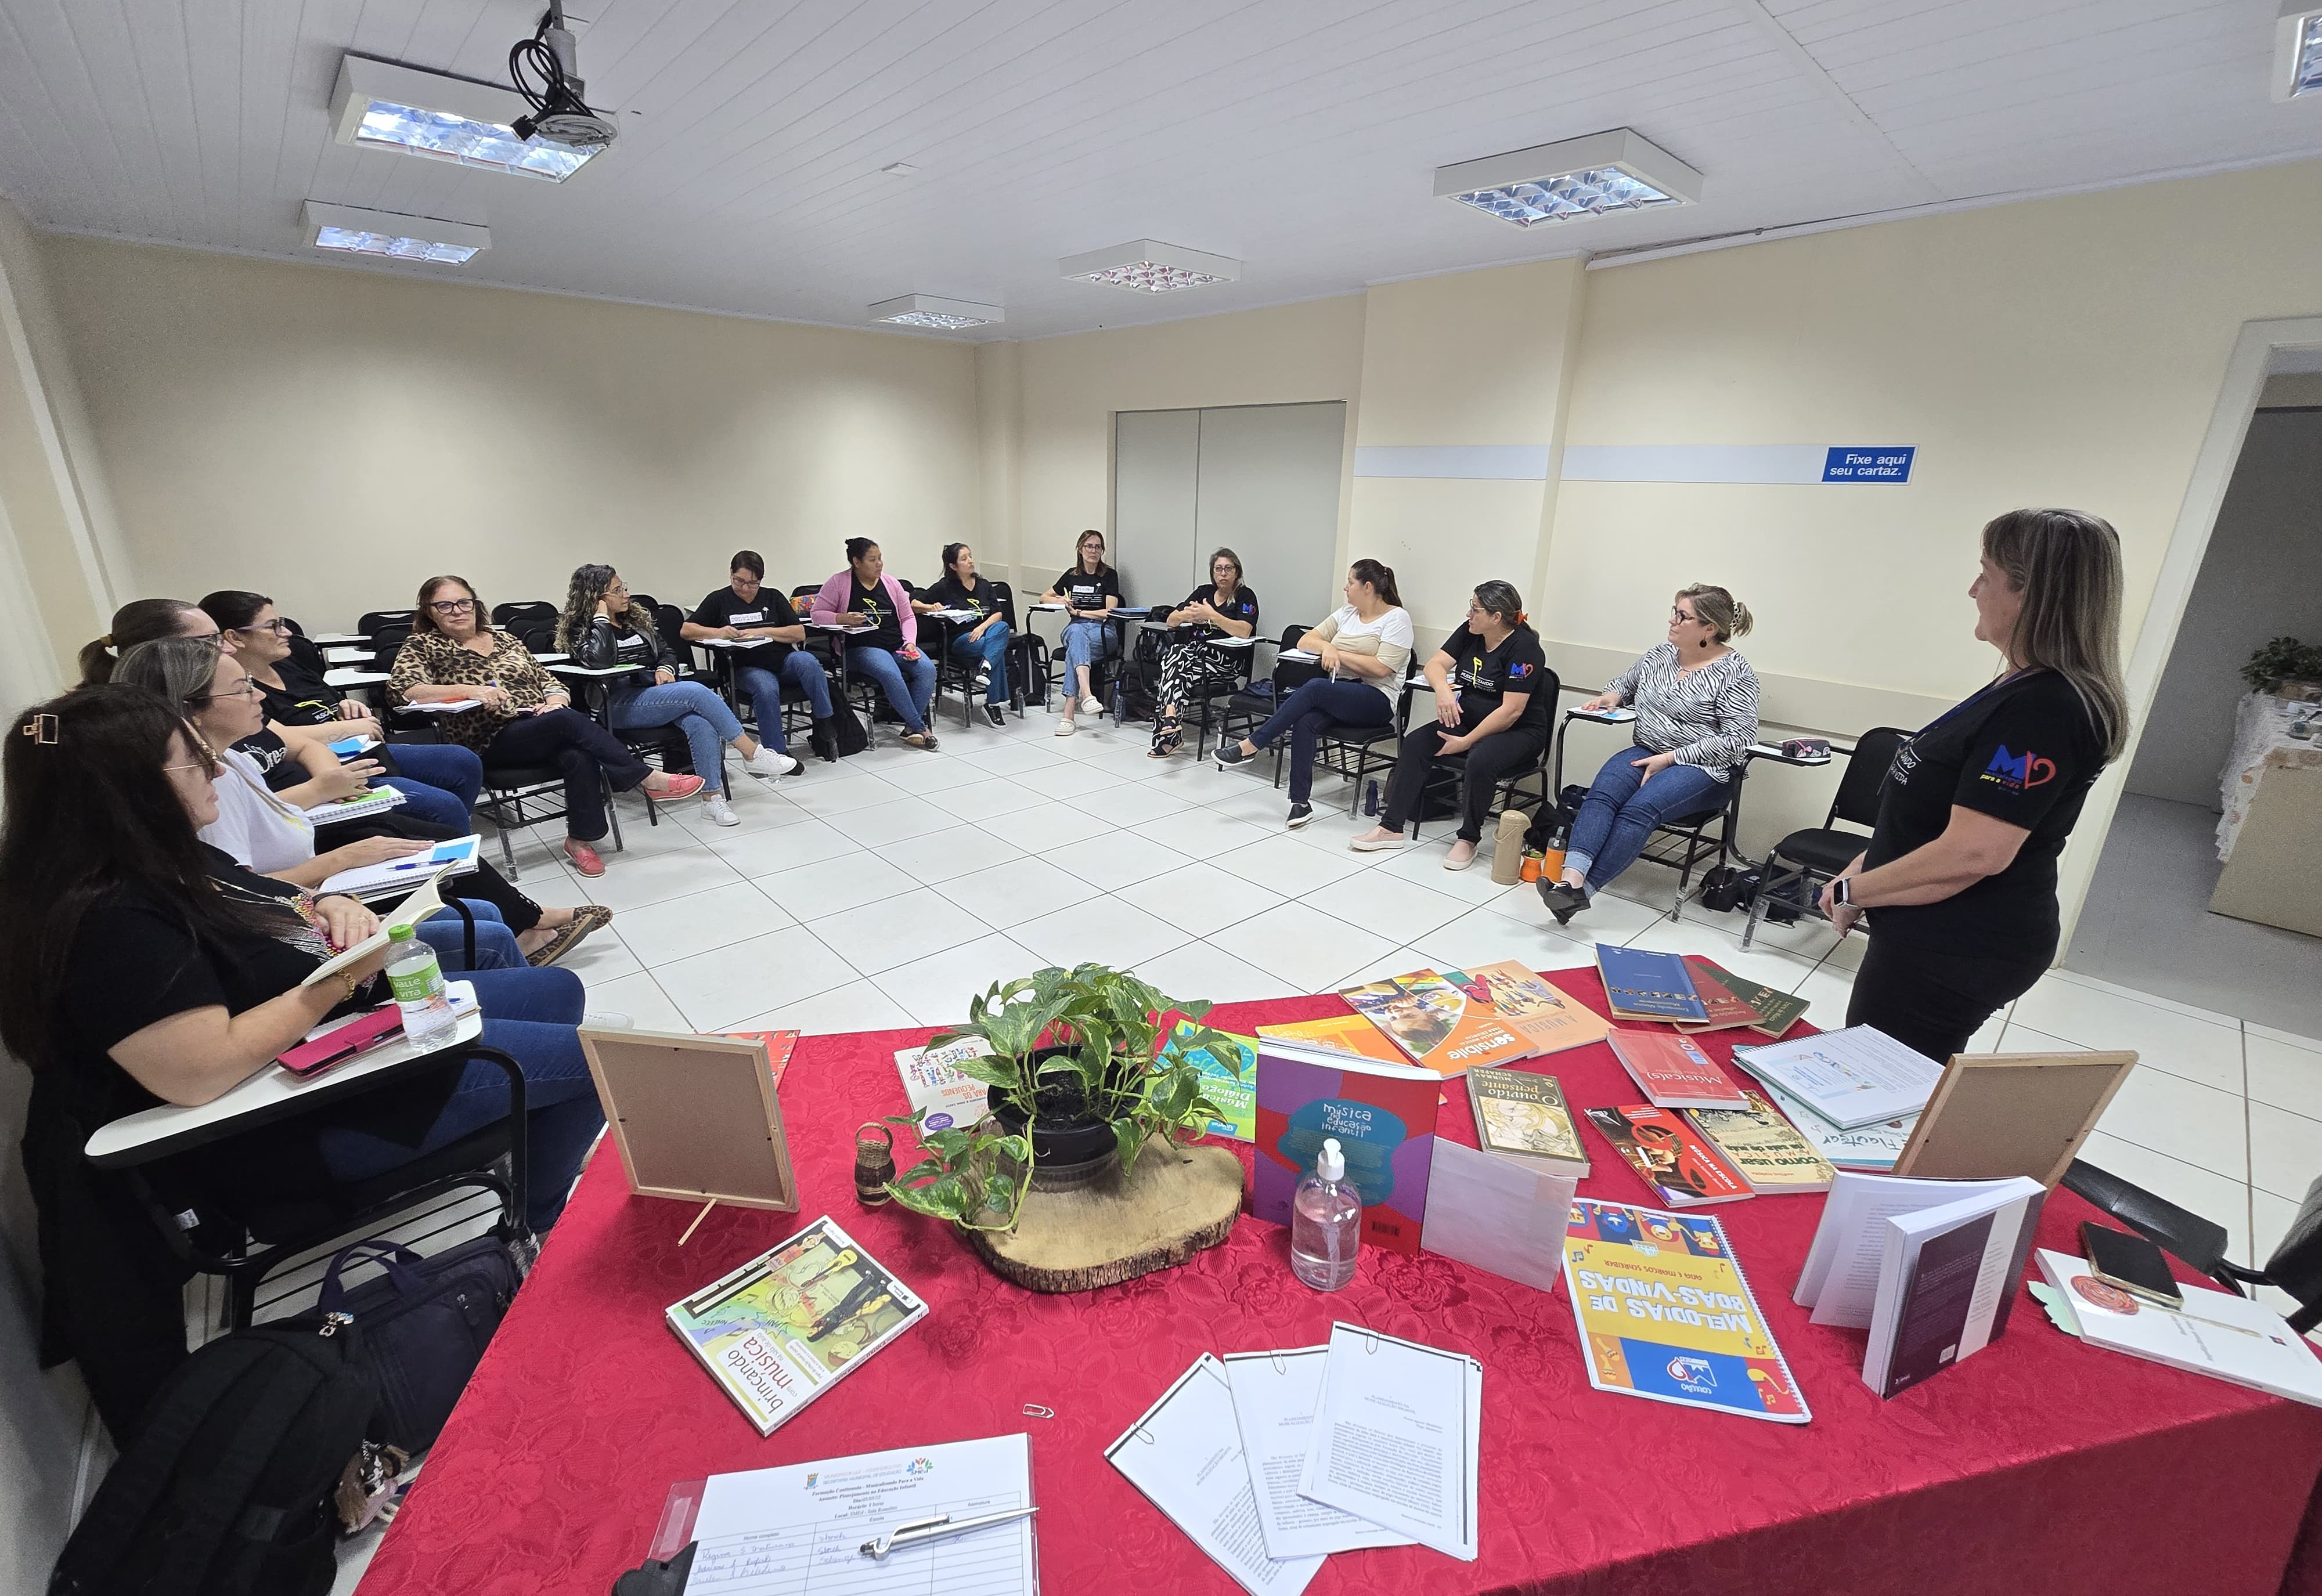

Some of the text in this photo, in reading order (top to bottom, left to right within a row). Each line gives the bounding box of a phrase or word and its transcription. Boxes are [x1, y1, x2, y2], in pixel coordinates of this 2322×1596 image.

[1846, 454, 1907, 467] Fixe aqui
[1830, 466, 1902, 475] seu cartaz.
[1472, 1067, 1513, 1078] SCHAFER
[1474, 1072, 1512, 1082] MURRAY
[1646, 1072, 1723, 1084] Música(s)
[940, 1084, 975, 1097] PEQUENOS
[973, 1088, 987, 1097] ARA
[1481, 1081, 1538, 1093] pensante
[1201, 1085, 1250, 1102] Diálogo
[1487, 1088, 1538, 1100] ouvido
[1323, 1103, 1372, 1121] música
[1739, 1157, 1820, 1166] como usar
[1715, 1170, 1737, 1190] ESCOLA
[1642, 1265, 1676, 1277] MARCOS
[1577, 1269, 1747, 1313] BOAS-VINDAS
[1589, 1294, 1753, 1334] DE MELODIAS
[742, 1337, 798, 1398] com música
[727, 1349, 784, 1414] brincando
